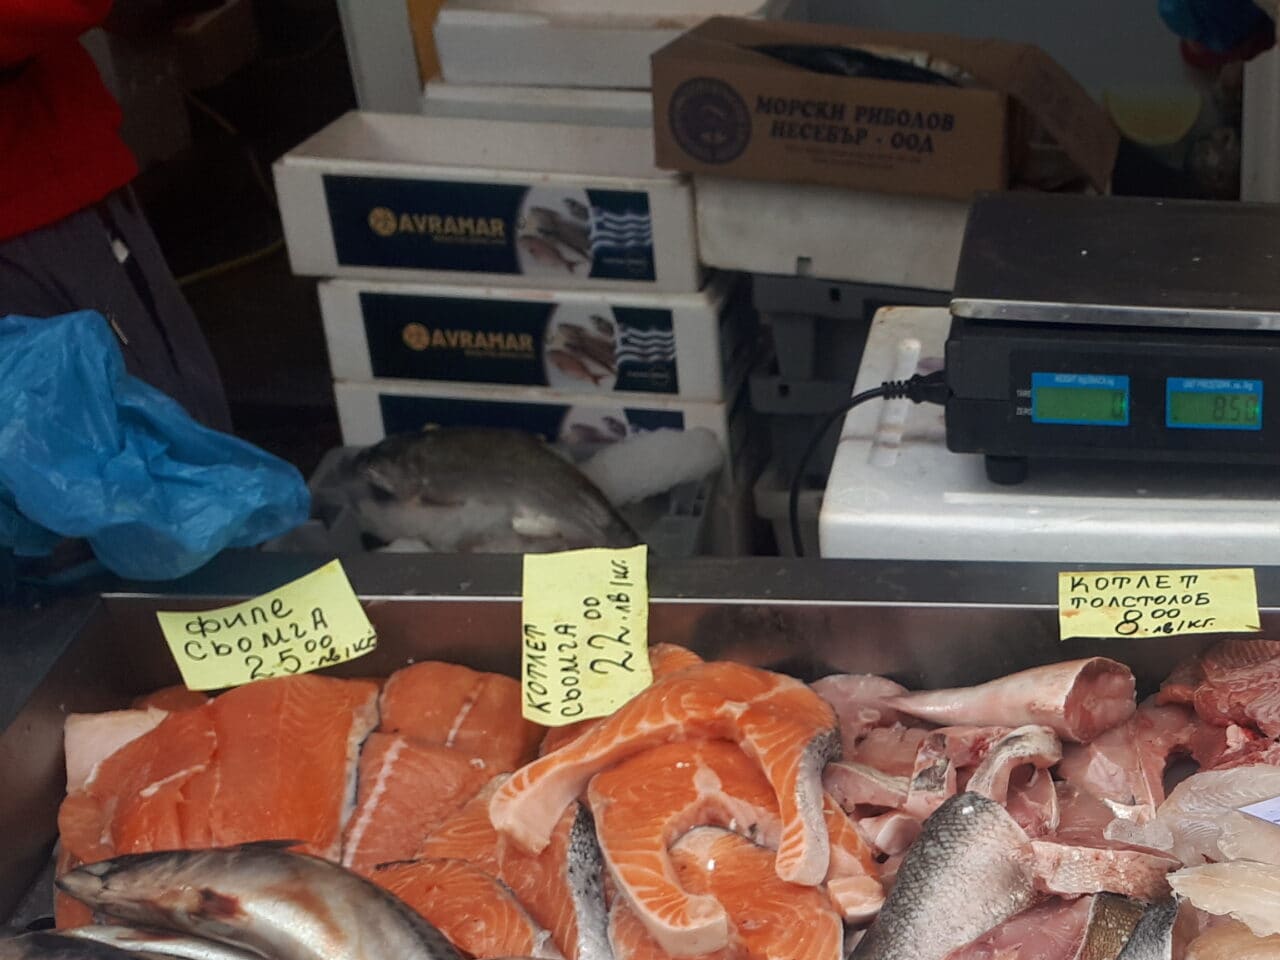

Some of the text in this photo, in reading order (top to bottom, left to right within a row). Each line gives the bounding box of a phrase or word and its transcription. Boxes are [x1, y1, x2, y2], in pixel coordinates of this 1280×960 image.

[755, 94, 955, 132] МОРСКИ РИБОЛОВ
[770, 118, 935, 153] НЕСЕБЪР ООД
[398, 215, 506, 237] AVRAMAR
[431, 329, 534, 351] AVRAMAR
[1070, 575, 1199, 592] КОТЛЕТ
[1071, 593, 1210, 609] ТОЛСТОЛОБ
[524, 623, 551, 714] КОТЛЕТ
